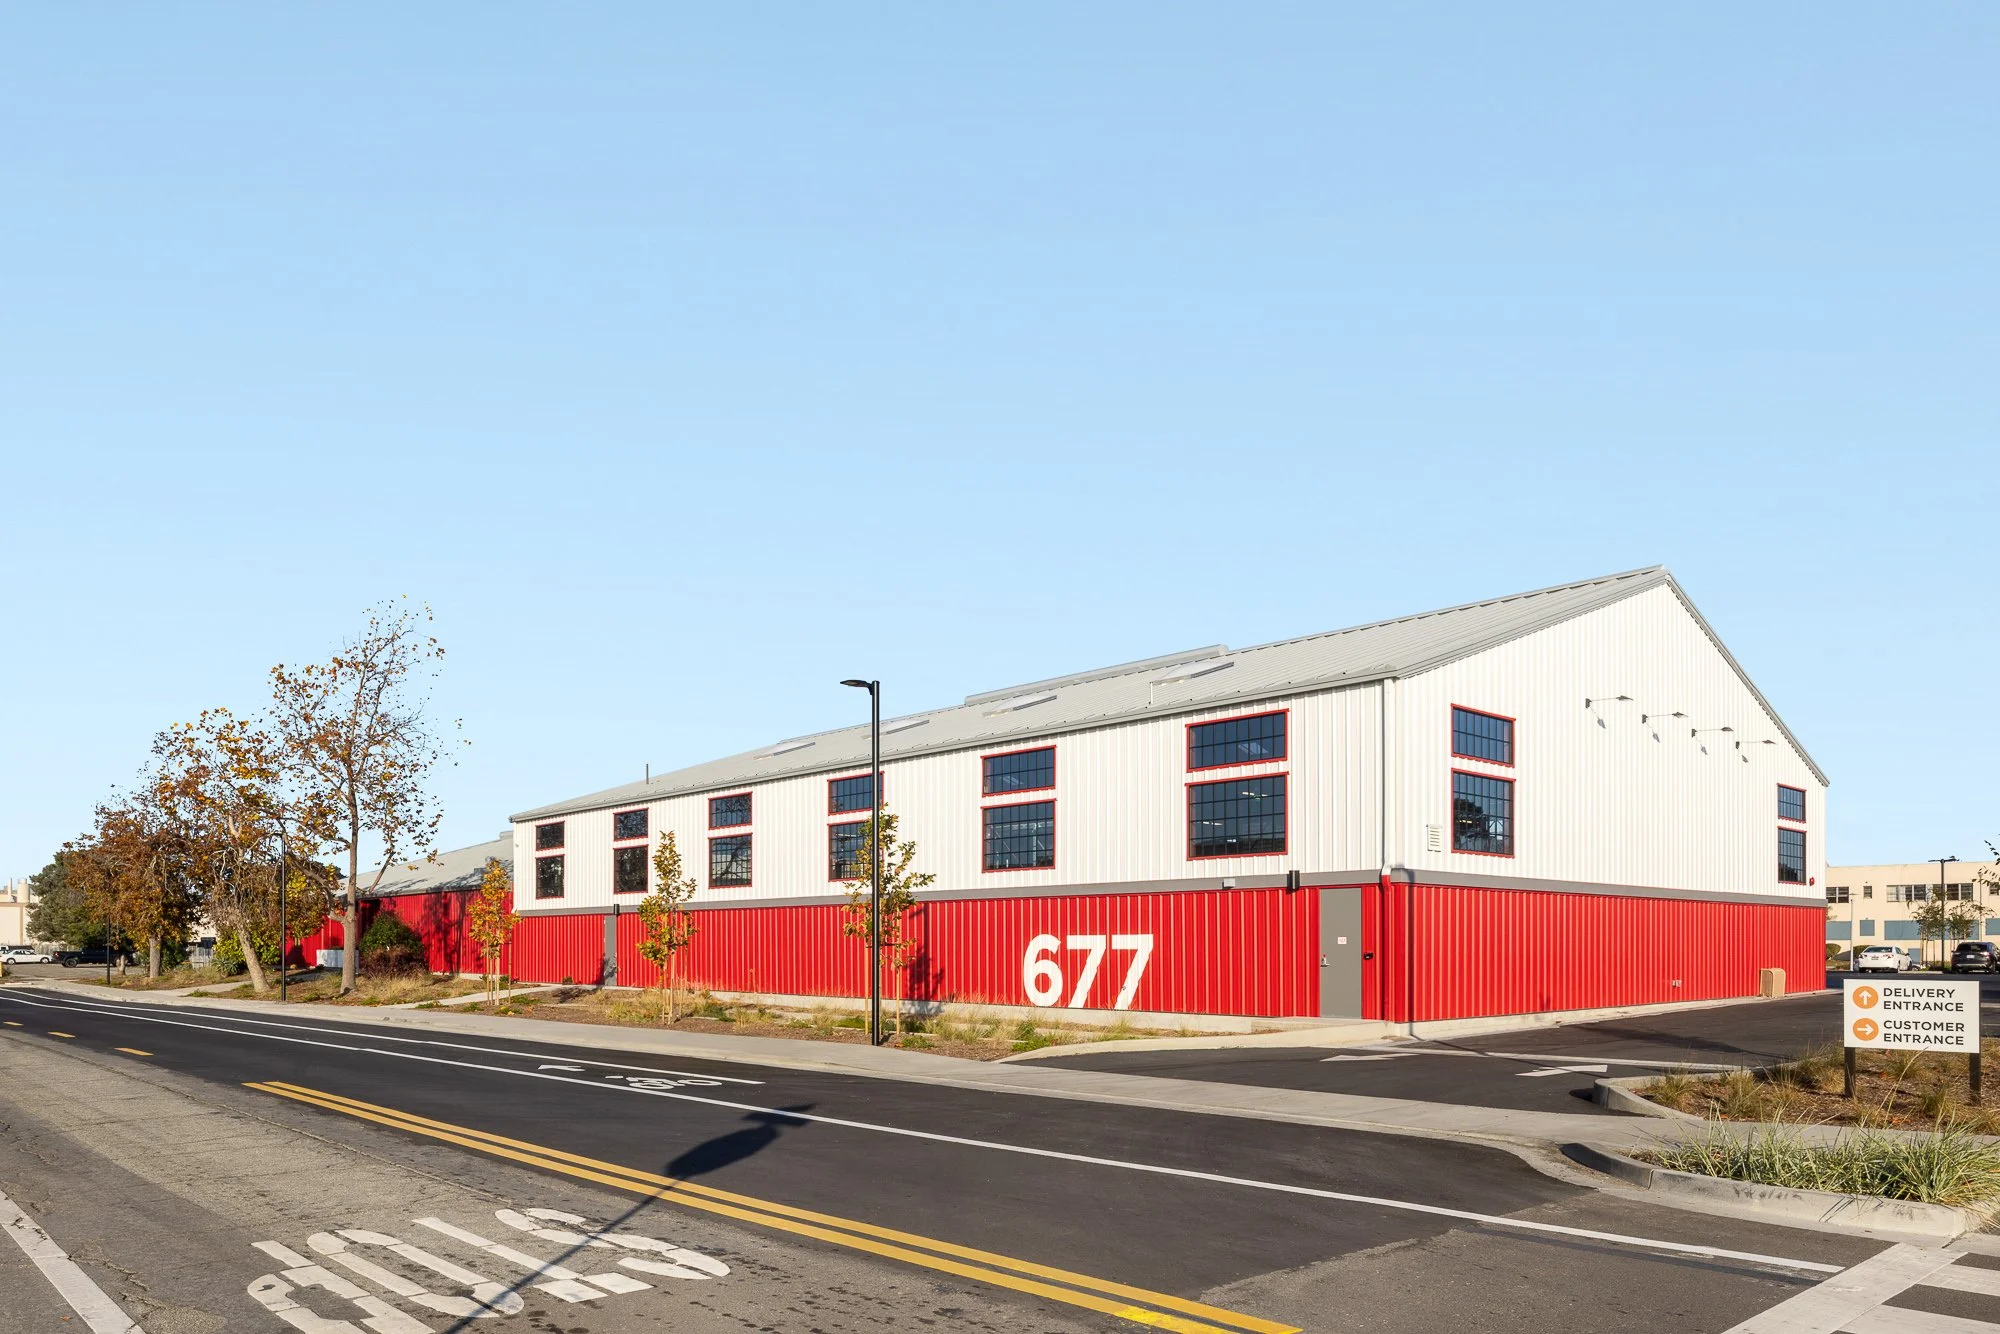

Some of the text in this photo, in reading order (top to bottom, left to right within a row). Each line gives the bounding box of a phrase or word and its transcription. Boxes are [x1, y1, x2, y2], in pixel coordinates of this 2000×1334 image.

[1023, 933, 1154, 1010] 677
[1883, 987, 1956, 998] DELIVERY
[1883, 1000, 1964, 1012] ENTRANCE
[1883, 1020, 1965, 1032] CUSTOMER
[1883, 1033, 1964, 1046] ENTRANCE
[247, 1208, 731, 1334] STOP
